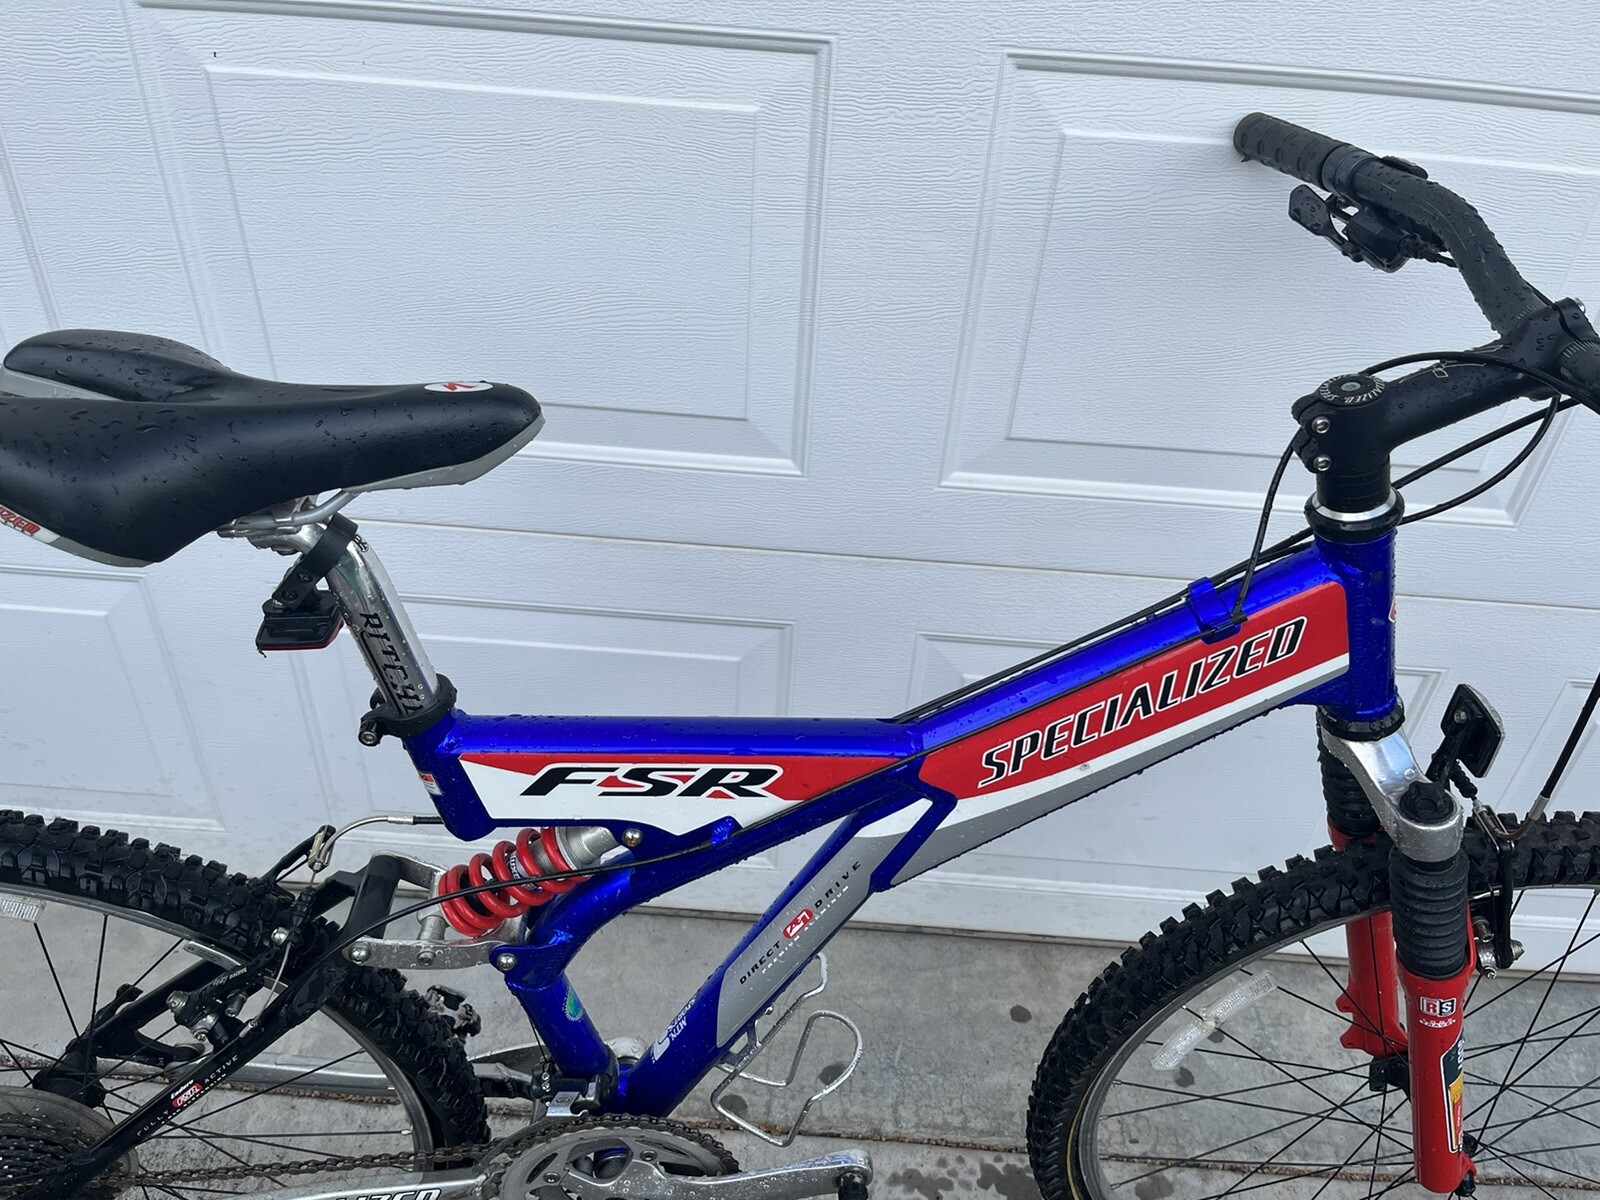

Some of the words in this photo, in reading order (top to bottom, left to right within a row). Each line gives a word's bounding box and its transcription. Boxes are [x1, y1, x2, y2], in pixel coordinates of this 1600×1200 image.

[977, 616, 1308, 789] SPECIALIZED
[519, 765, 779, 798] FSR
[739, 940, 781, 985] DIRECT
[814, 861, 862, 909] DRIVE
[761, 934, 801, 975] PREMIUM
[136, 1109, 169, 1137] FULLY
[204, 1054, 239, 1084] ACTIVE
